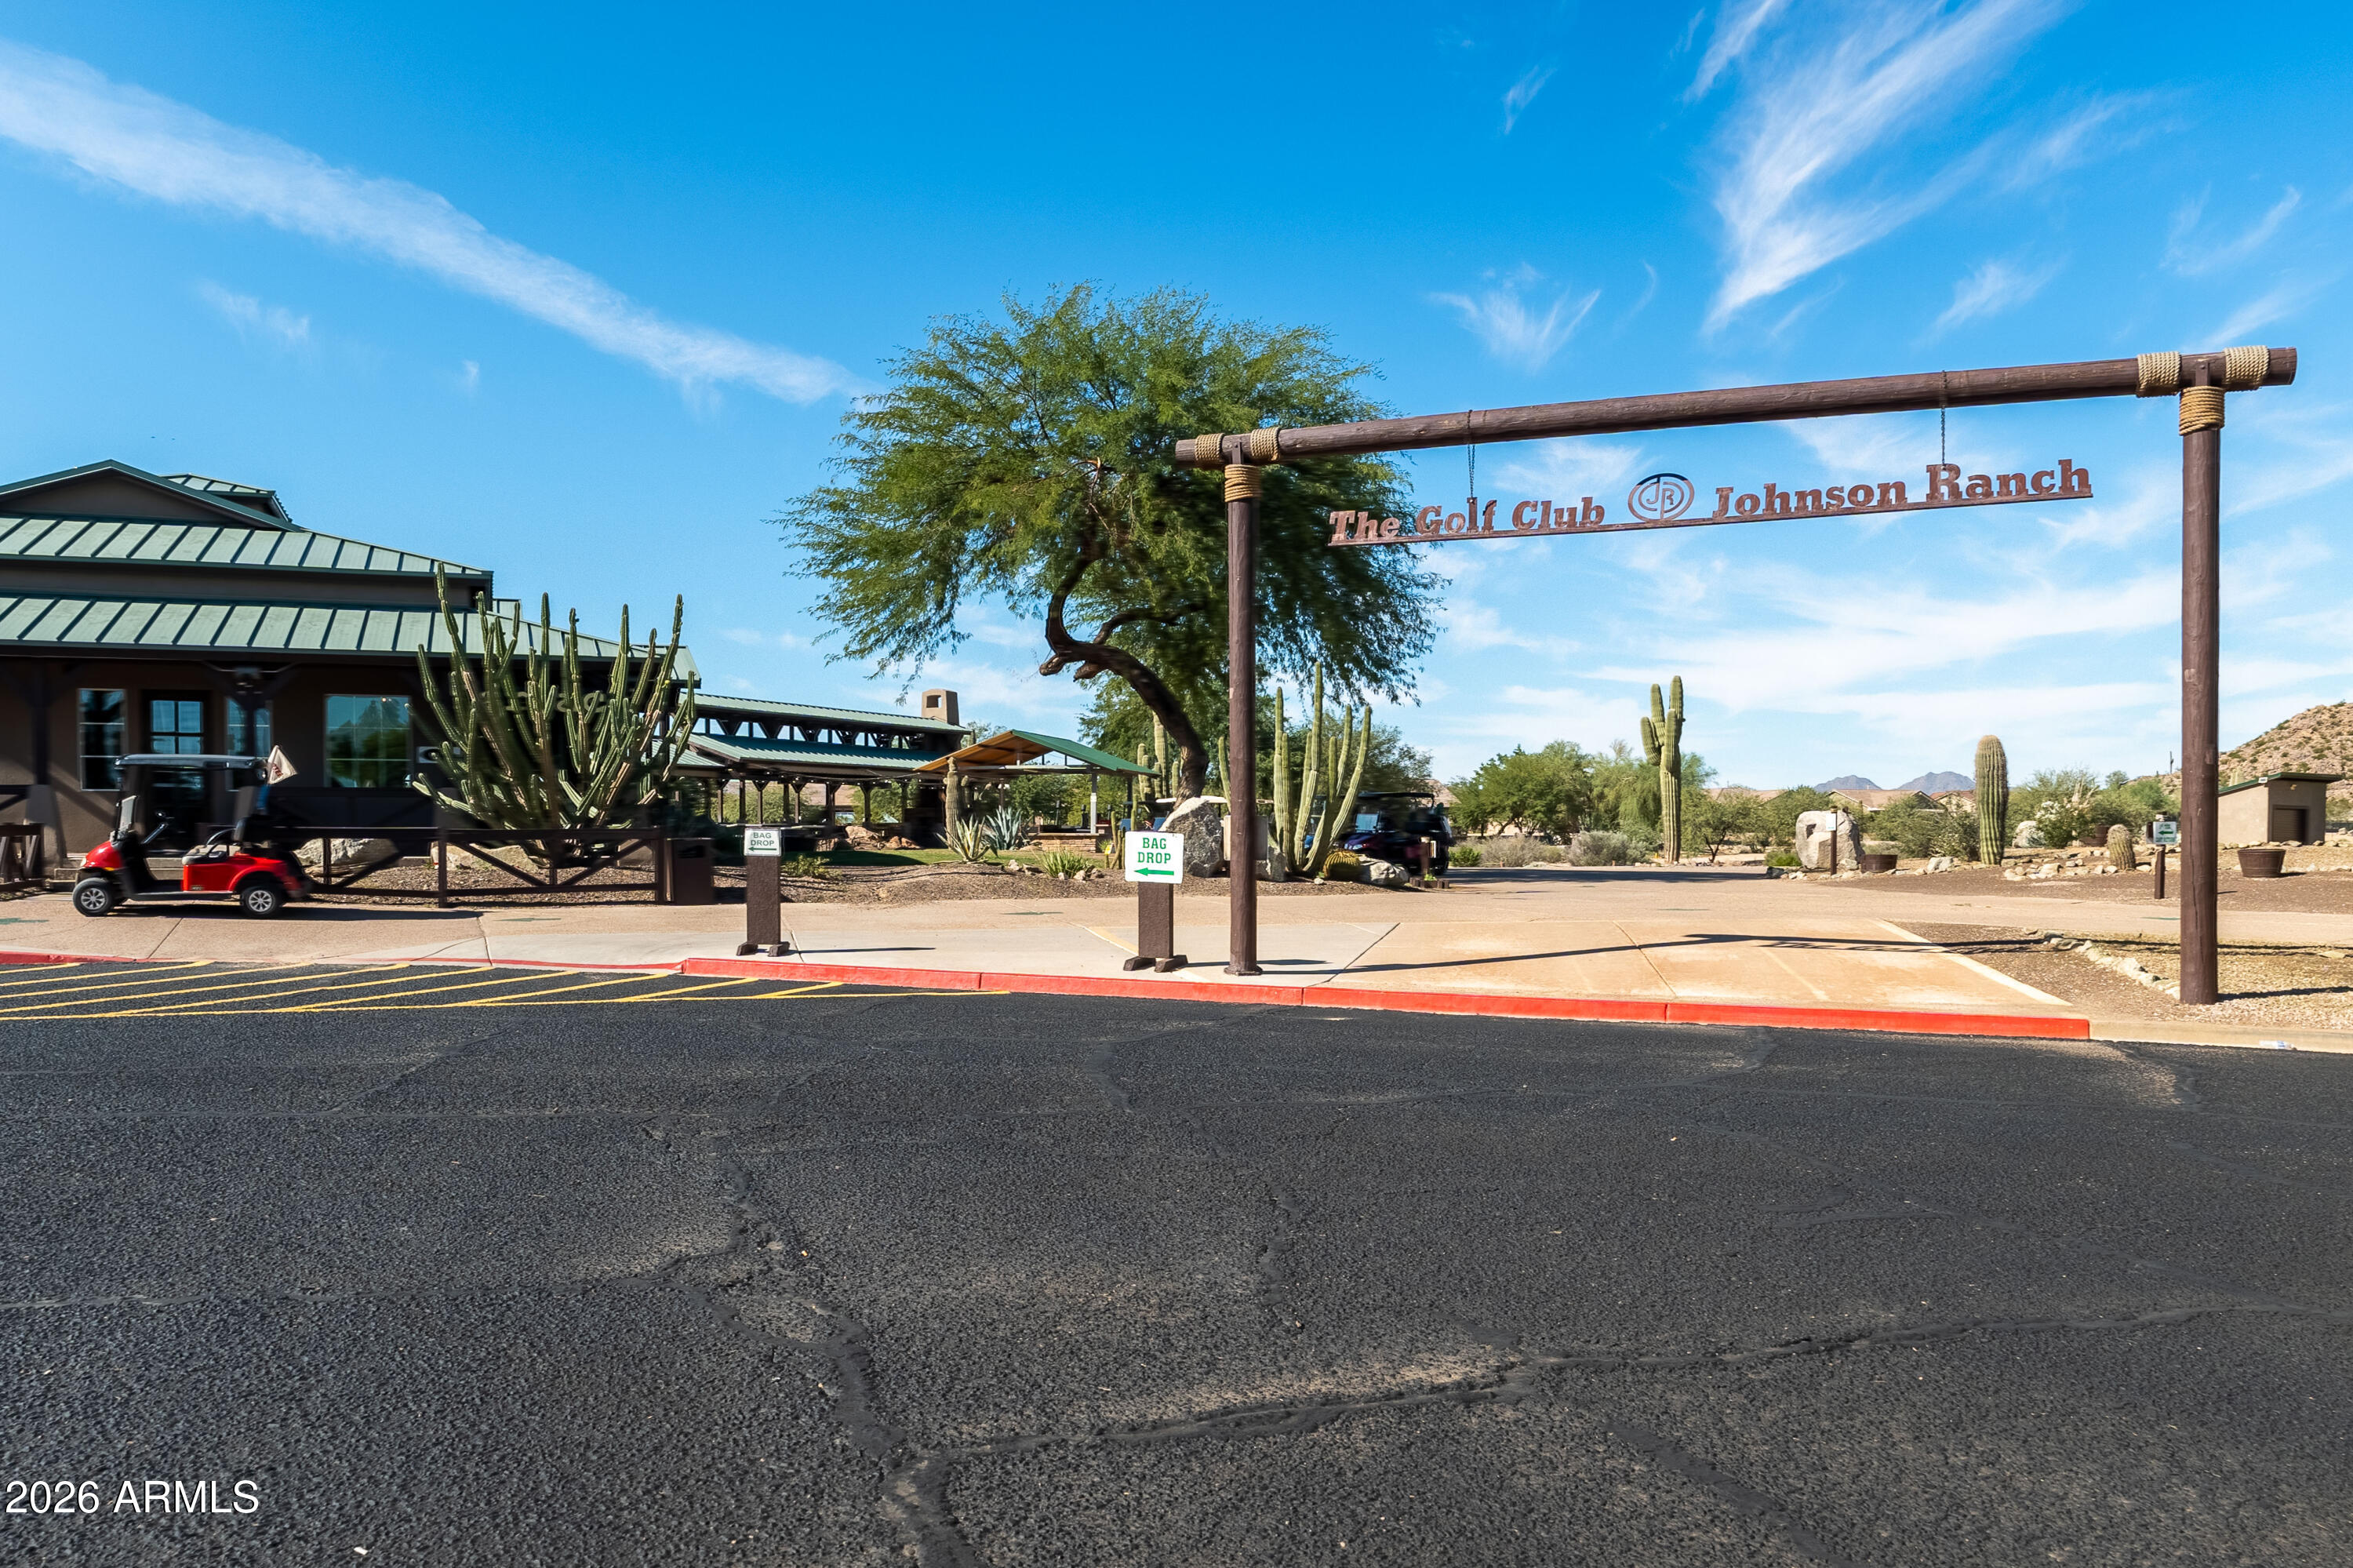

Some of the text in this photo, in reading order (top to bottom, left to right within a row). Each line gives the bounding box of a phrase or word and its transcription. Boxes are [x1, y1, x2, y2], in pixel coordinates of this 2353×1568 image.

[1329, 511, 1399, 543] The
[1416, 497, 1497, 535] Golf
[1512, 497, 1605, 529] Club
[1711, 481, 1907, 519] Johnson
[1926, 459, 2092, 503] Ranch
[1142, 837, 1167, 849] BAG
[1137, 852, 1171, 864] DROP
